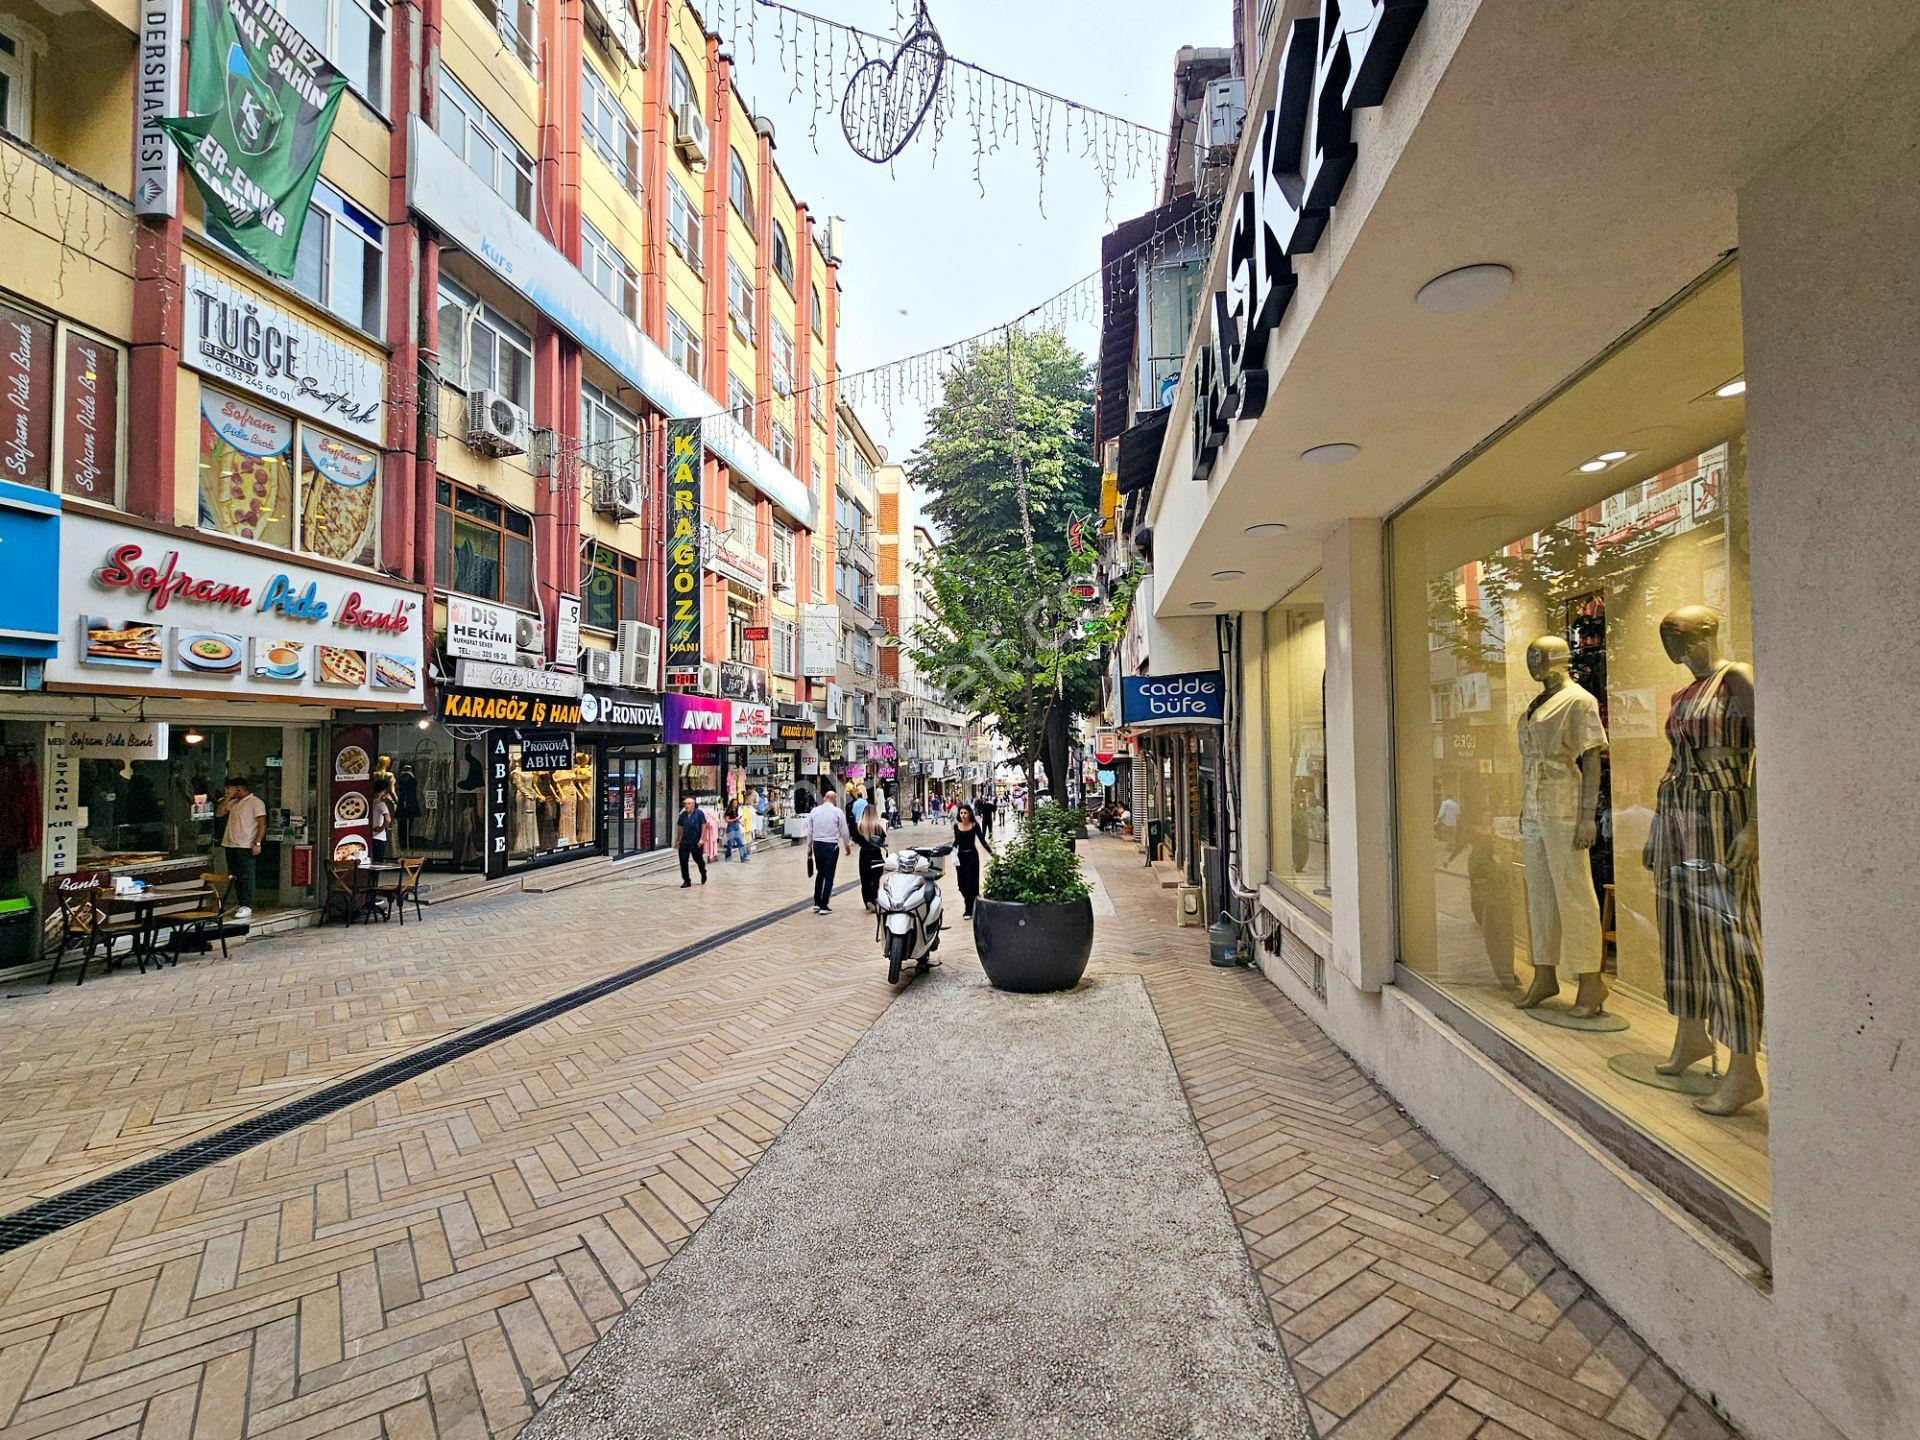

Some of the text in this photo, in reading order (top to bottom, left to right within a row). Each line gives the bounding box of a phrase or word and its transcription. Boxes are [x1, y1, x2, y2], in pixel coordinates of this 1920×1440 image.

[141, 12, 168, 173] DERSHANESİ
[480, 234, 514, 275] kurs
[195, 289, 299, 381] TUĞÇE
[204, 341, 258, 373] BEAUTY
[5, 322, 35, 475] Sofram Pide Bank
[215, 363, 291, 402] 0 533 245 60 01
[76, 347, 101, 492] Sofram Pide Bnk
[221, 400, 277, 434] Sofram
[673, 435, 695, 621] KARAGÖZ
[99, 544, 410, 633] Sofram Pide Bank
[454, 624, 512, 644] HEKİMİ
[670, 642, 699, 652] HANI
[1139, 679, 1216, 696] cadde
[445, 695, 580, 727] KARAGÖZ İŞ HANI
[600, 697, 664, 726] PRONOVA
[683, 710, 723, 731] AVON
[1150, 698, 1207, 714] büfe
[70, 732, 154, 750] Sofram Pide Bank
[523, 739, 569, 752] PRONOVA
[526, 753, 567, 769] ABİYE
[495, 739, 506, 853] ABİYE
[59, 874, 100, 891] Bank
